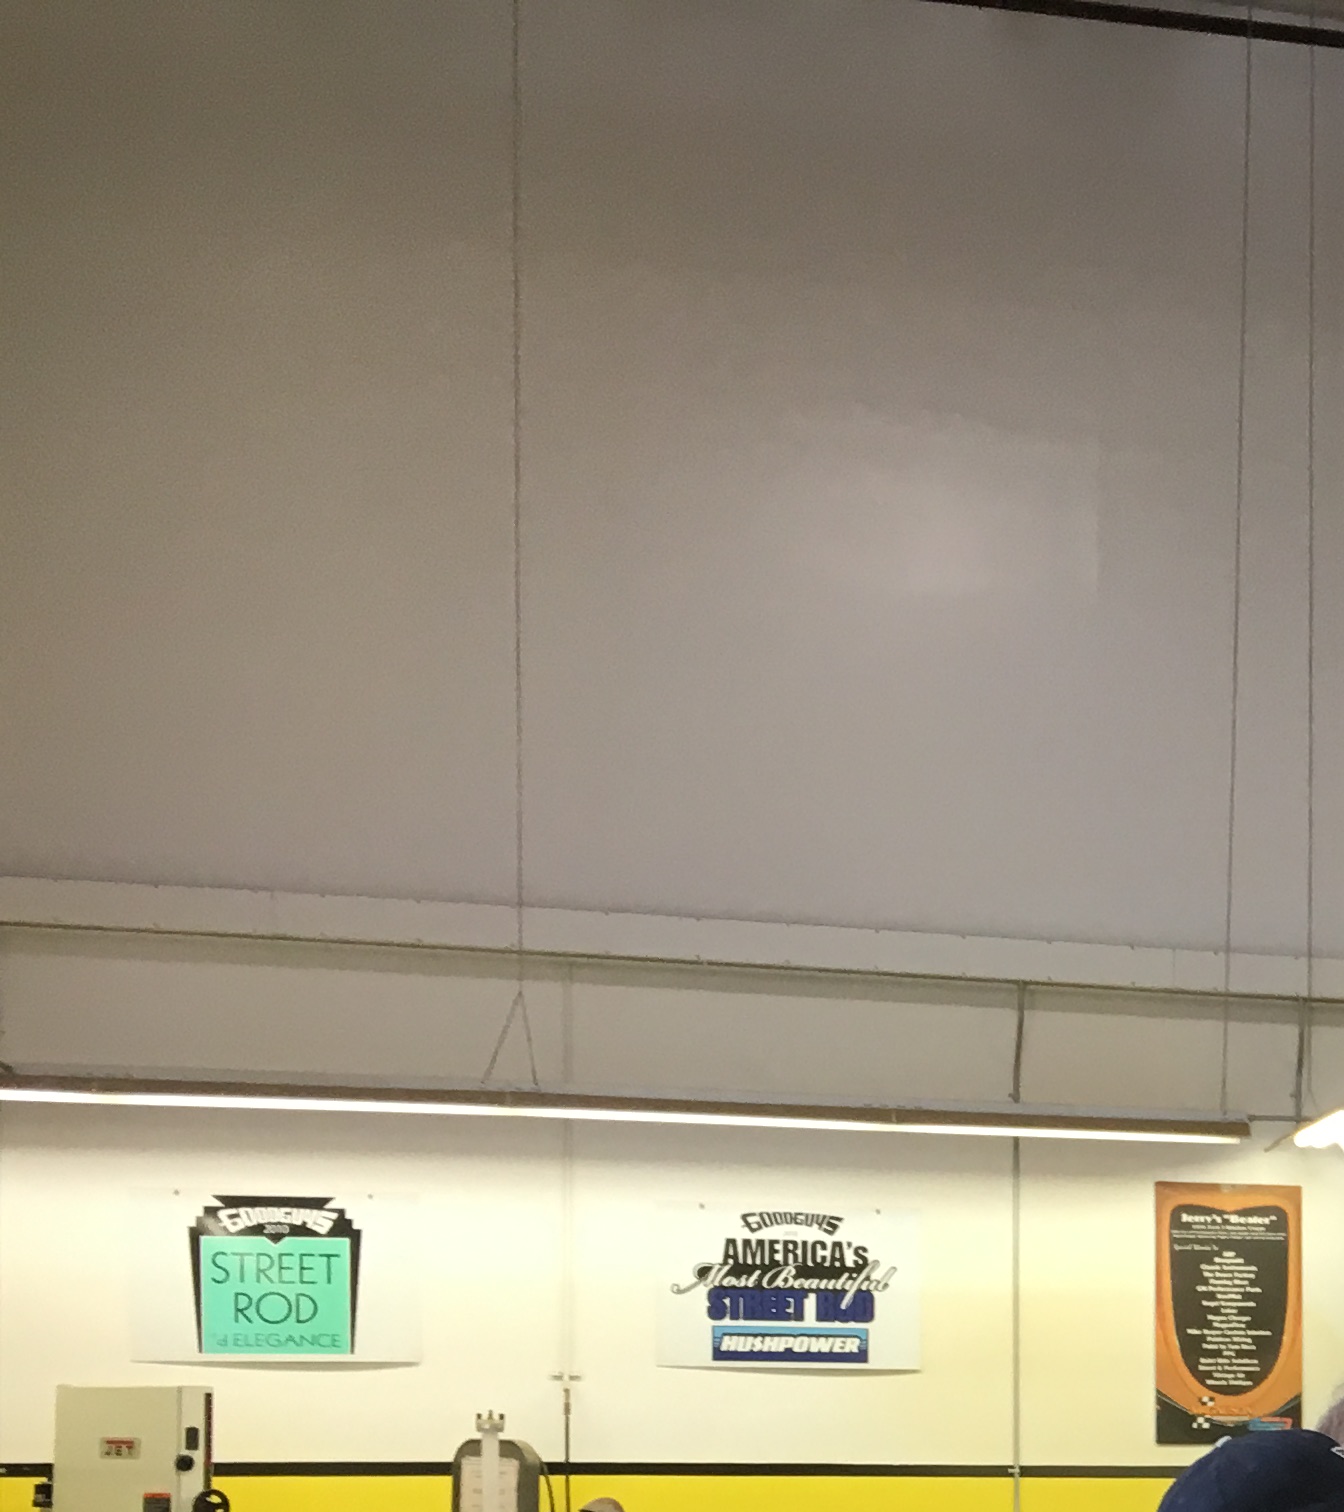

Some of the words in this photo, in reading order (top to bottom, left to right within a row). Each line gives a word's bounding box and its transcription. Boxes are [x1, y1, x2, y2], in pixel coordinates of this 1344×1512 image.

[740, 1211, 845, 1236] GOODGUYS
[210, 1251, 341, 1285] STREET
[670, 1262, 762, 1294] Most
[762, 1260, 897, 1310] Beautiful
[233, 1291, 319, 1324] ROD
[707, 1287, 809, 1321] STREET
[719, 1335, 862, 1354] HUSHPOWER
